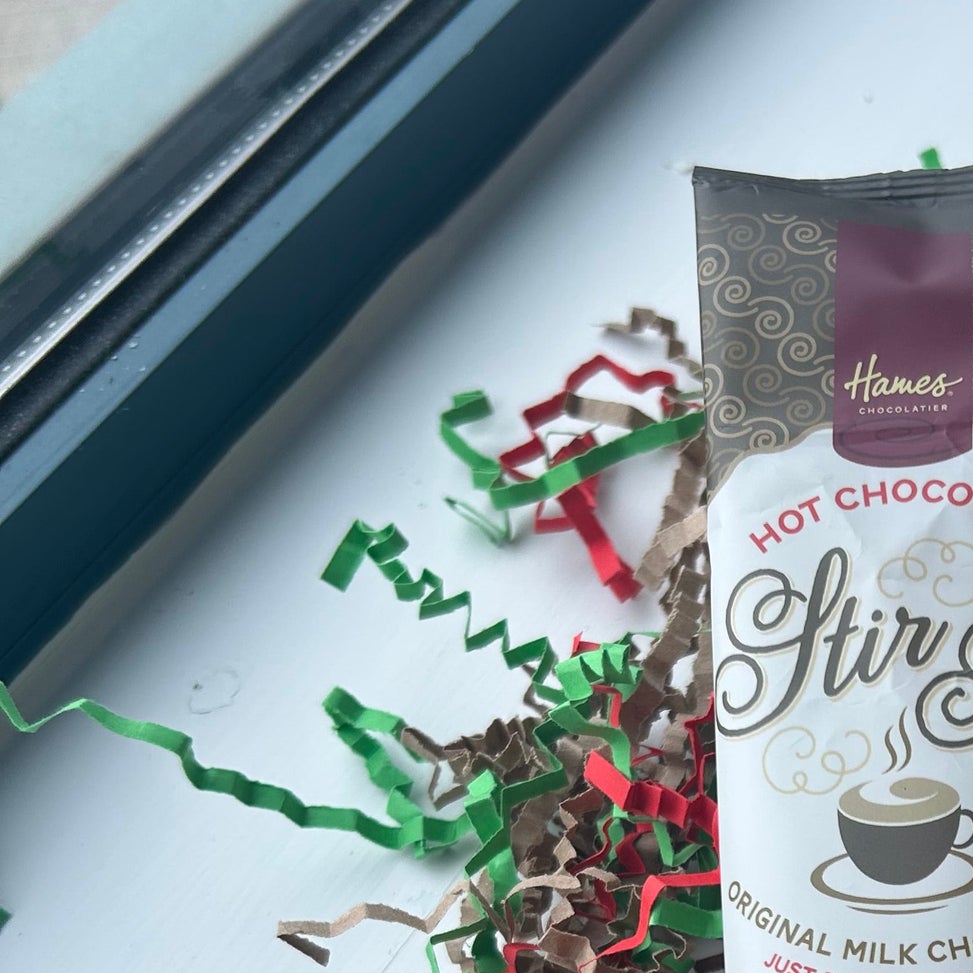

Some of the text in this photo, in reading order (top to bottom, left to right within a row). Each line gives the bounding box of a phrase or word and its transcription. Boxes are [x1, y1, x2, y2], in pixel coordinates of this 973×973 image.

[844, 353, 963, 402] Hames
[858, 404, 949, 415] CHOCOLATIER
[749, 496, 821, 554] HOT
[716, 547, 948, 738] Stir
[727, 881, 832, 956] ORIGINAL
[843, 938, 917, 965] MILK
